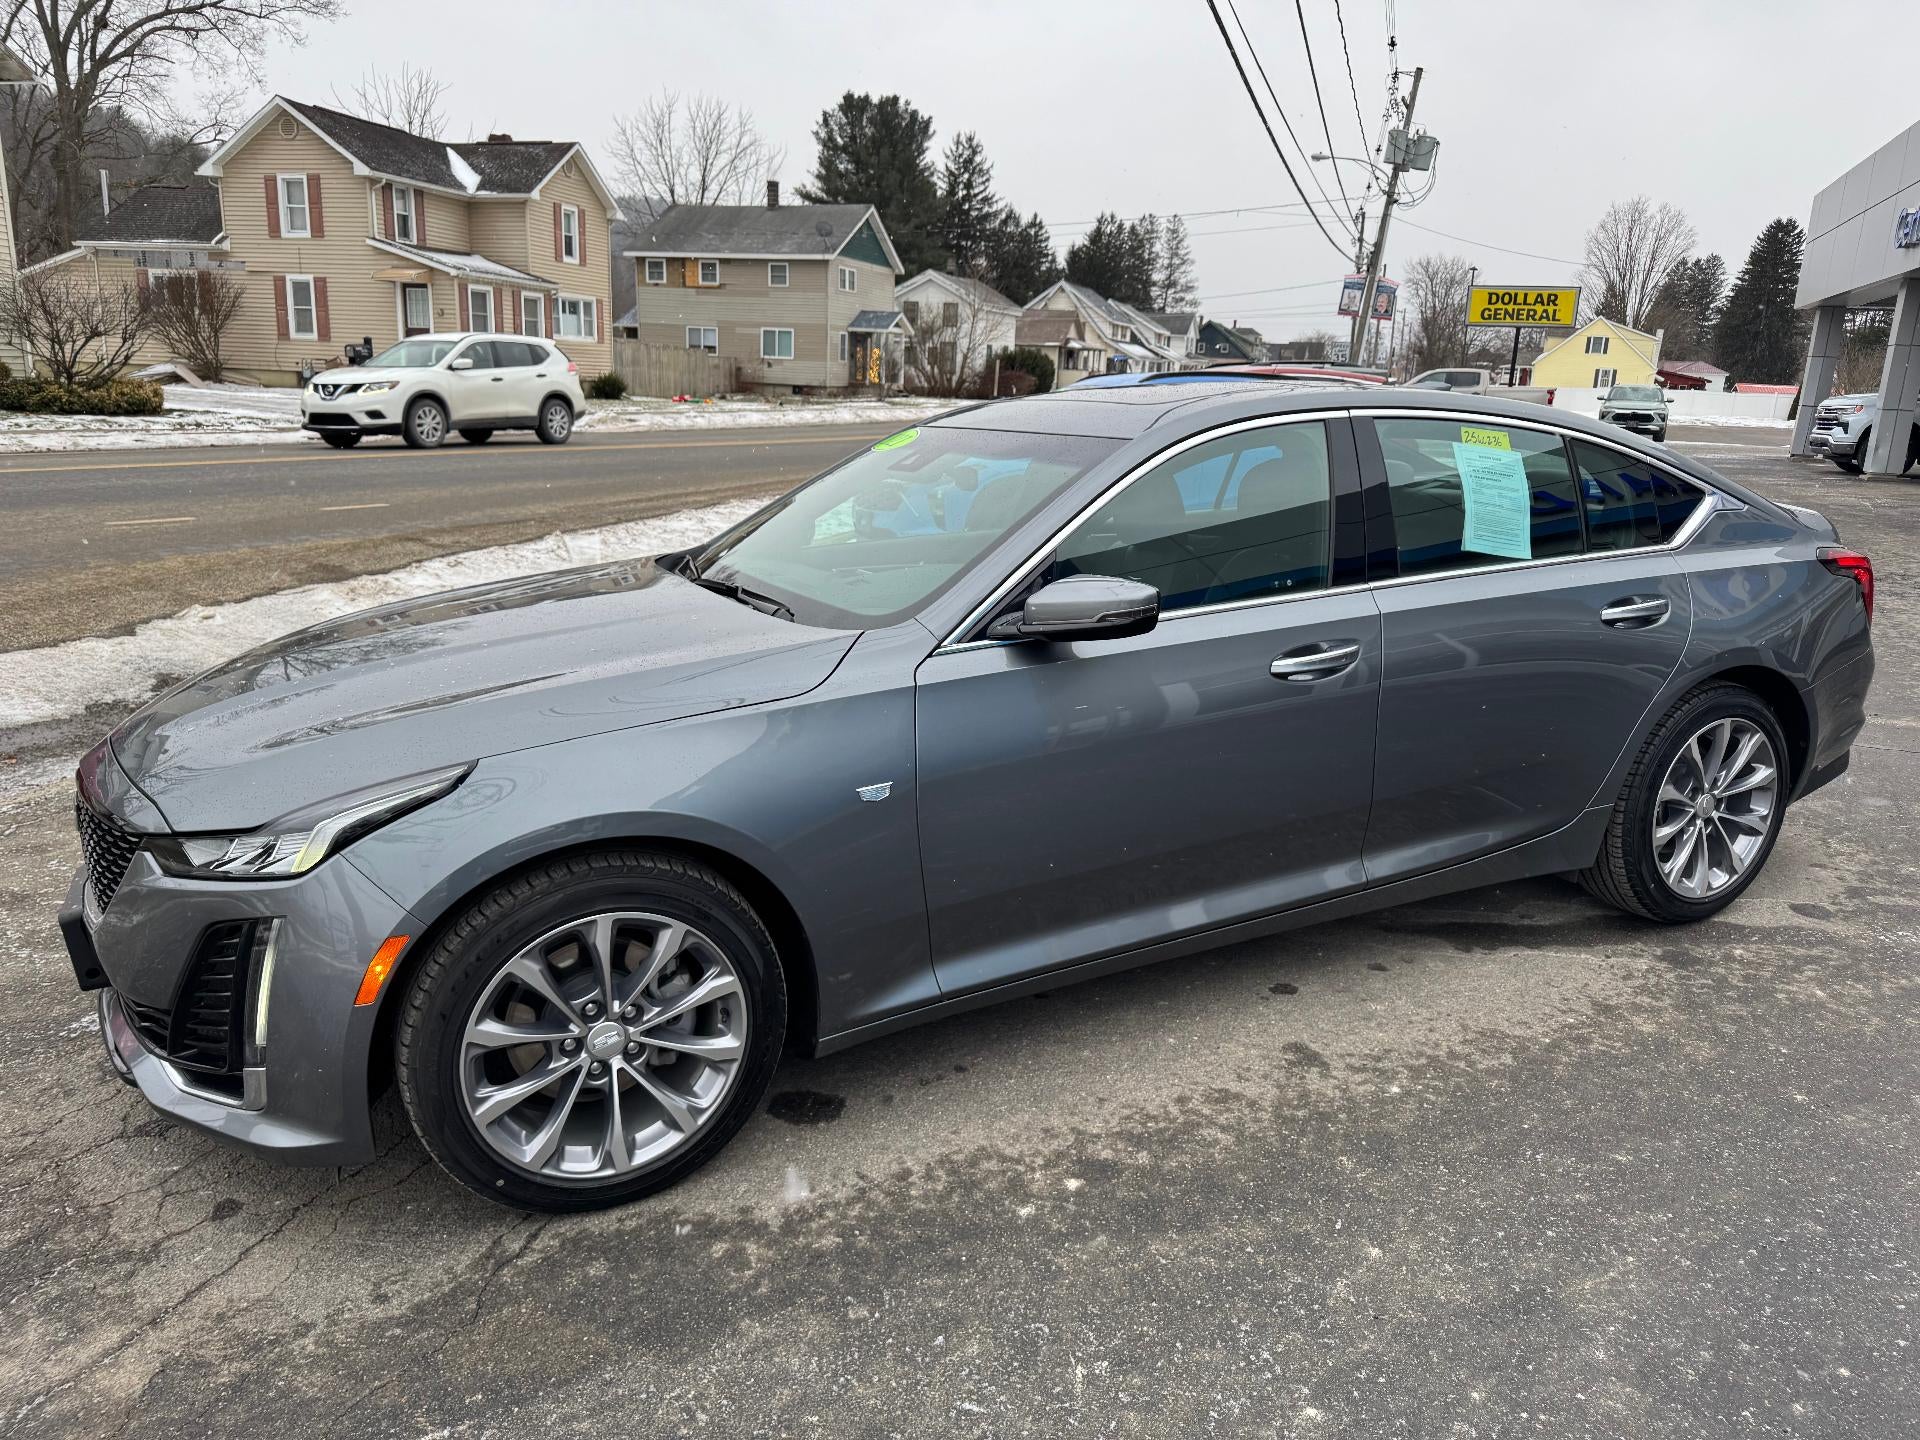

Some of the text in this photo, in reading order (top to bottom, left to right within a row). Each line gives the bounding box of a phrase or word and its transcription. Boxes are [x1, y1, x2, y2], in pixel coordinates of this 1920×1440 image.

[1487, 292, 1559, 307] DOLLAR
[1480, 307, 1561, 322] GENERAL
[1333, 353, 1347, 362] 35
